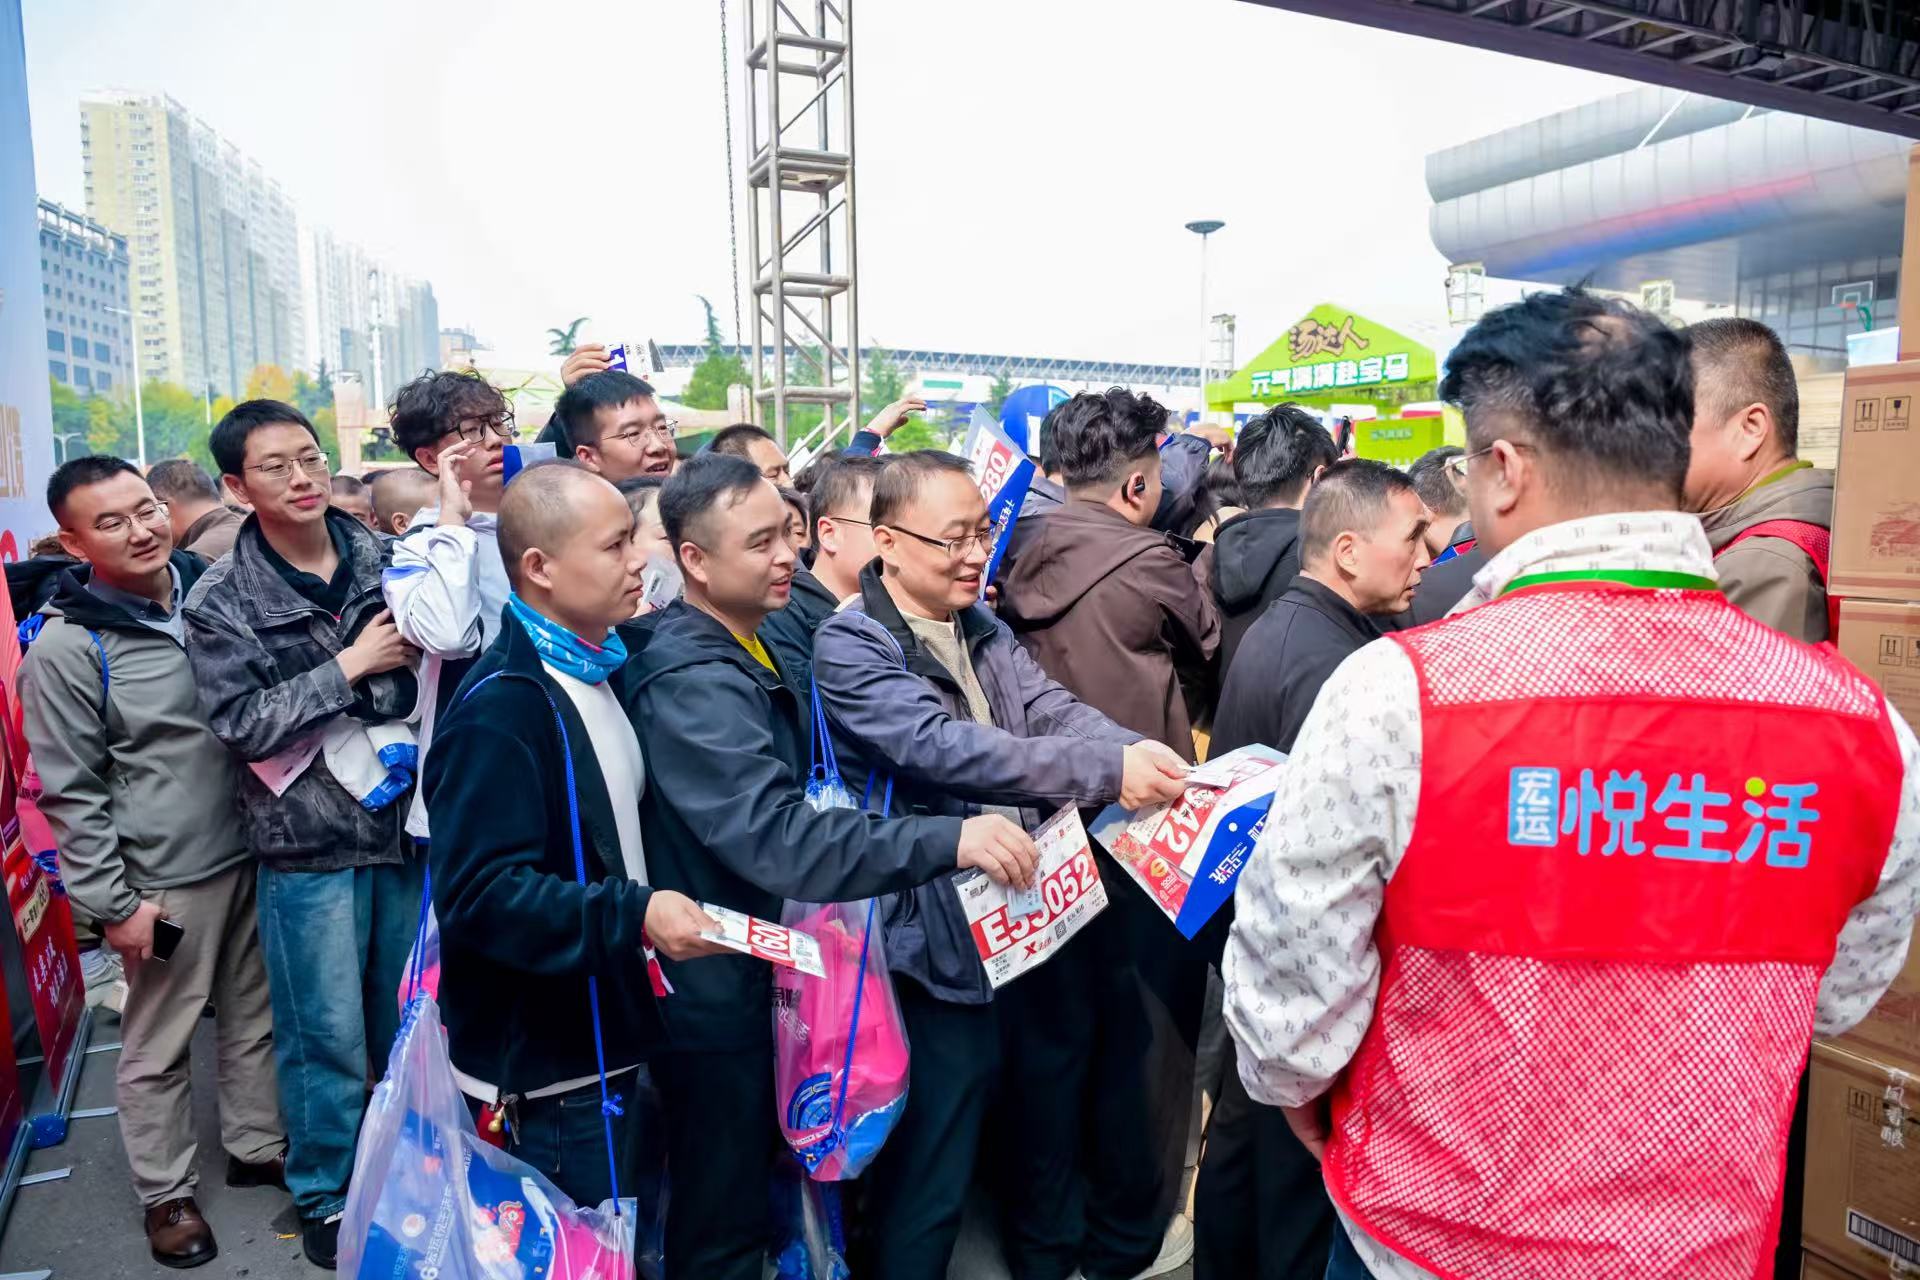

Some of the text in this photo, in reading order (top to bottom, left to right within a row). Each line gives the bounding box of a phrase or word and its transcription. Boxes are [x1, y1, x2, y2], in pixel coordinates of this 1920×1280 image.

[1514, 767, 1820, 868] 宏运 悦生活
